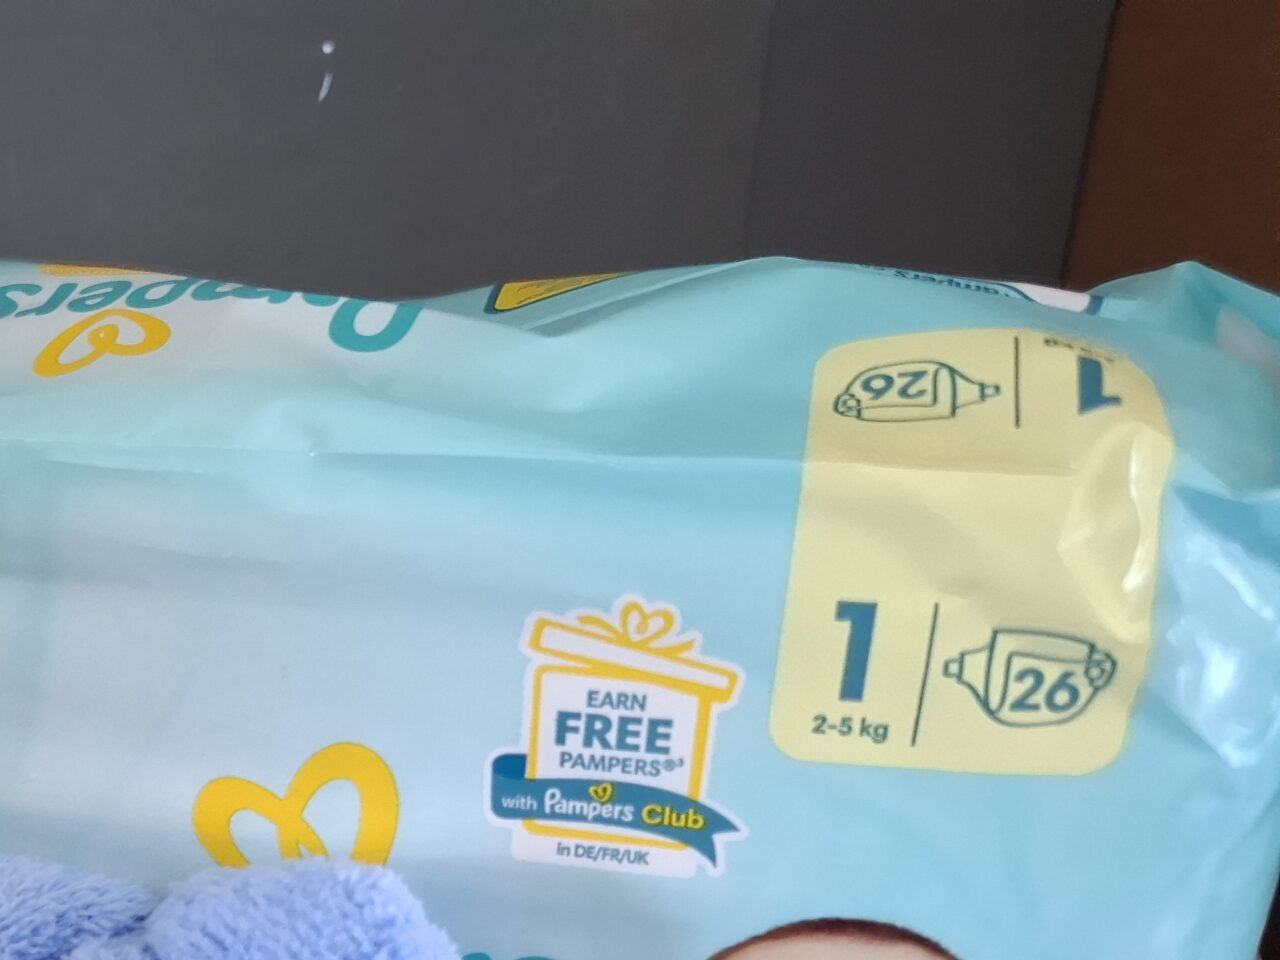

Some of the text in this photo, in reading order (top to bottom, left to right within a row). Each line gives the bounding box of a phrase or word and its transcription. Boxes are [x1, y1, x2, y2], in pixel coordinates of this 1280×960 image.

[894, 271, 1008, 297] ampers
[861, 369, 930, 400] 26
[1078, 356, 1124, 414] 1
[834, 600, 878, 703] 1
[586, 690, 648, 712] EARN
[1009, 669, 1080, 713] 26
[555, 710, 675, 755] FREE
[812, 714, 888, 744] 2-5 kg
[501, 788, 706, 830] with Pampers Club
[556, 841, 651, 866] in DE/FR/UK
